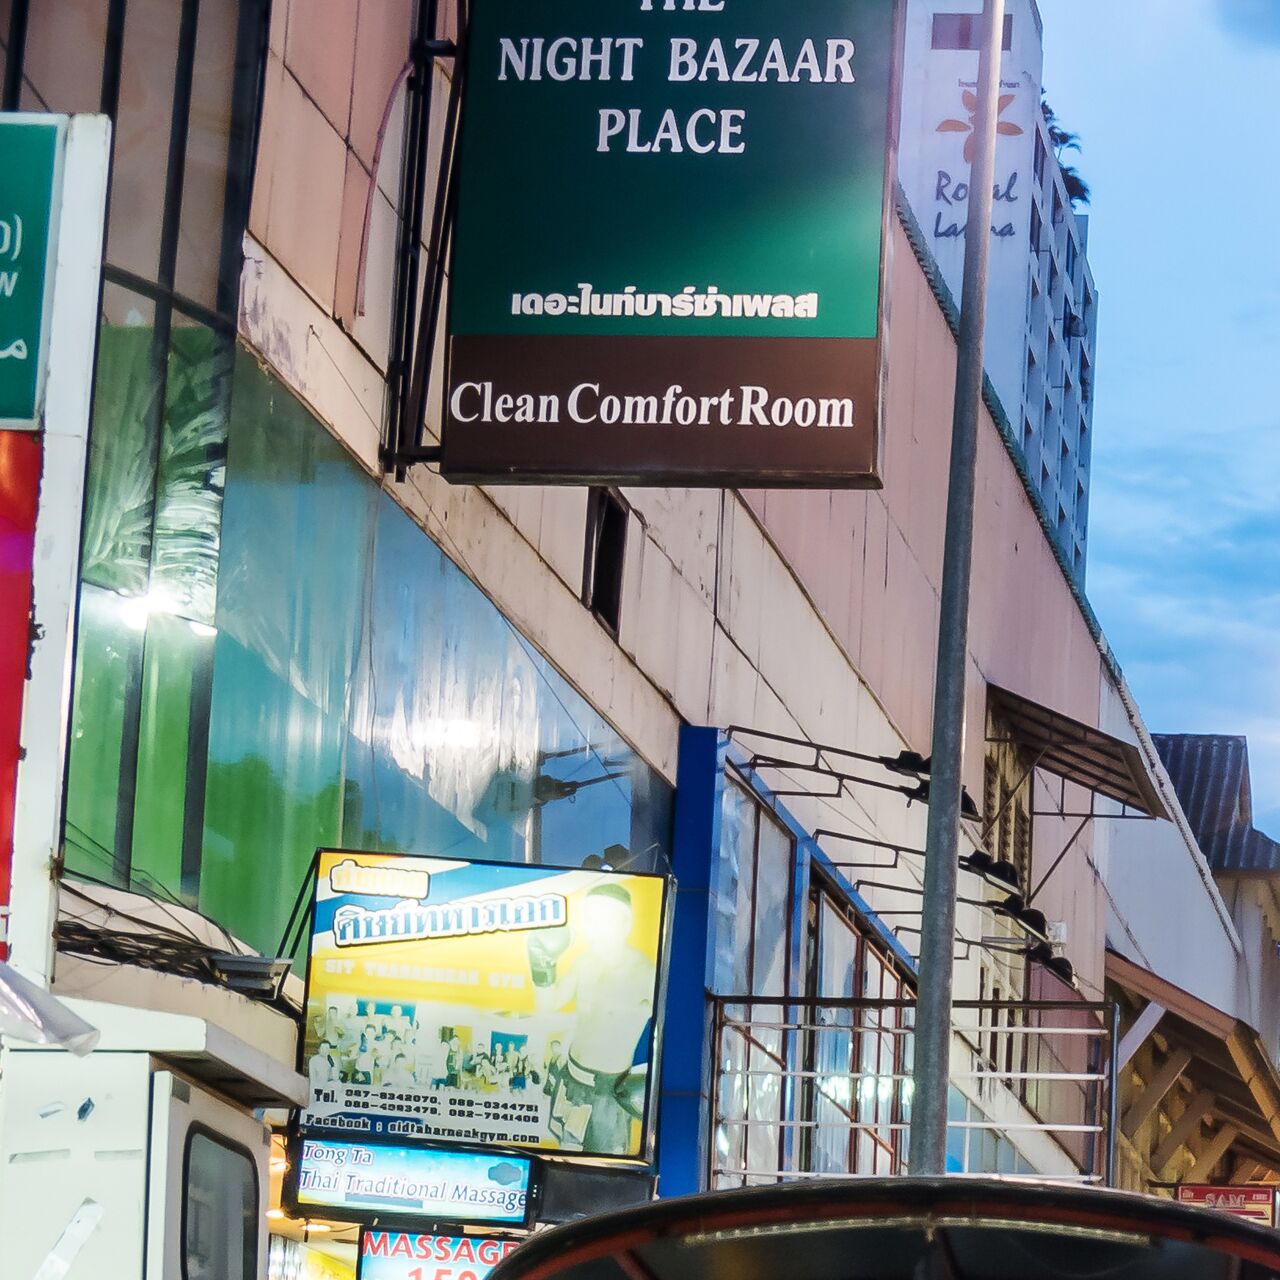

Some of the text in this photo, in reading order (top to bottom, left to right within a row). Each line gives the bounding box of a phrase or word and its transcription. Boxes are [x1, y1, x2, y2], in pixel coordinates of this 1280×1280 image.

[497, 37, 855, 84] NIGHT BAZAAR
[596, 109, 746, 153] PLACE
[936, 170, 1018, 205] Roal
[450, 381, 854, 427] Clean Comfort Room
[305, 1114, 370, 1130] Facebook
[304, 1145, 373, 1164] Tong Ta
[301, 1170, 527, 1212] Thai Traditional Massage
